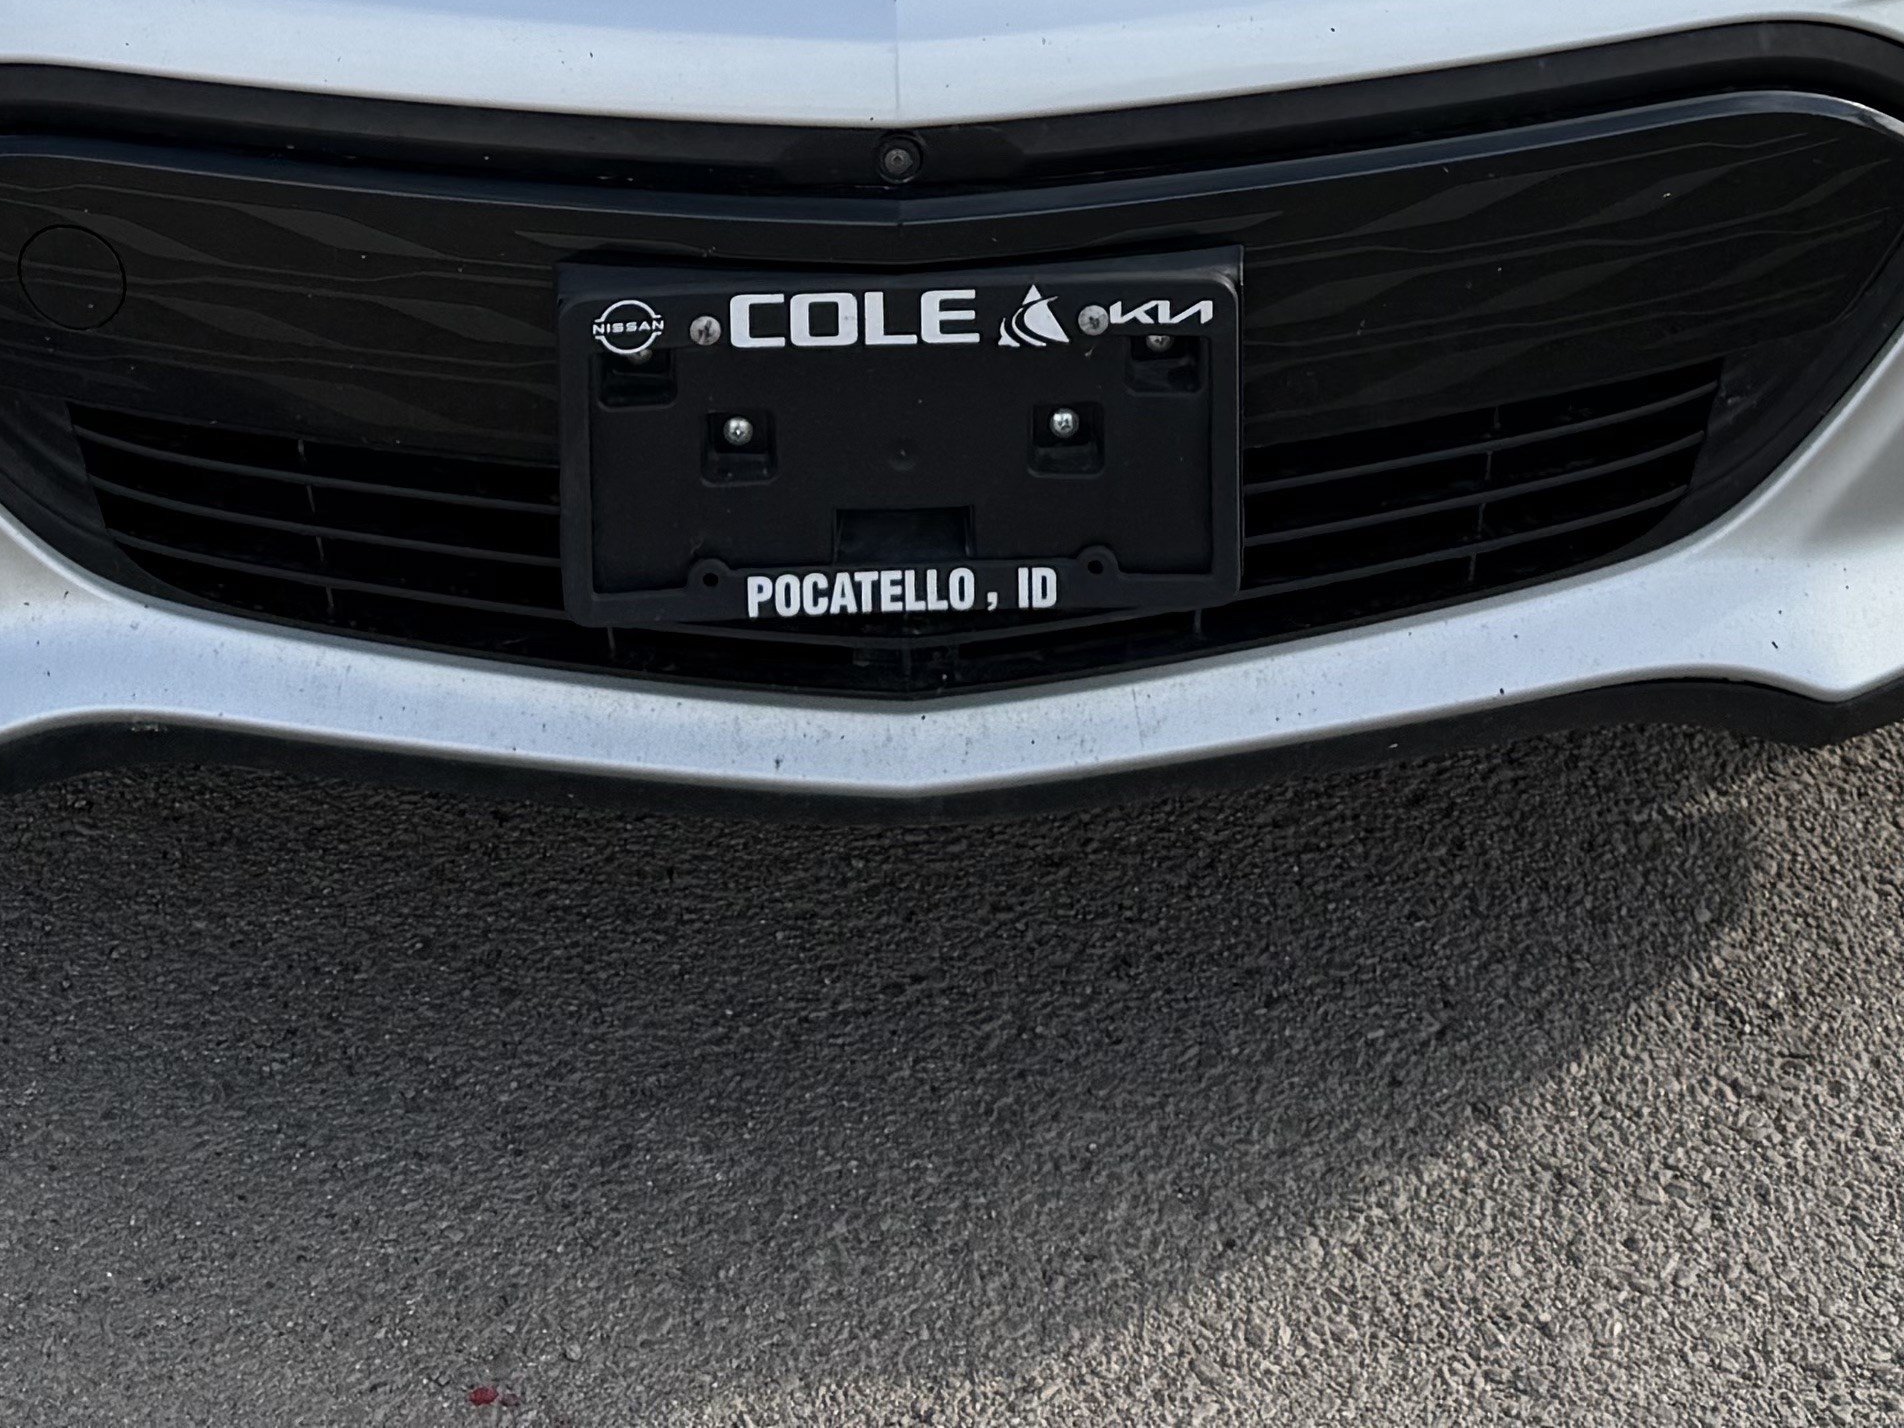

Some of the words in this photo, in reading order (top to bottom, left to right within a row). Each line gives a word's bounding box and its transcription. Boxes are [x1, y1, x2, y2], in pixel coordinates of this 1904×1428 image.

[592, 320, 665, 336] NISSAN
[728, 288, 981, 349] COLE
[1108, 299, 1214, 325] KIA
[1016, 566, 1058, 609] ID
